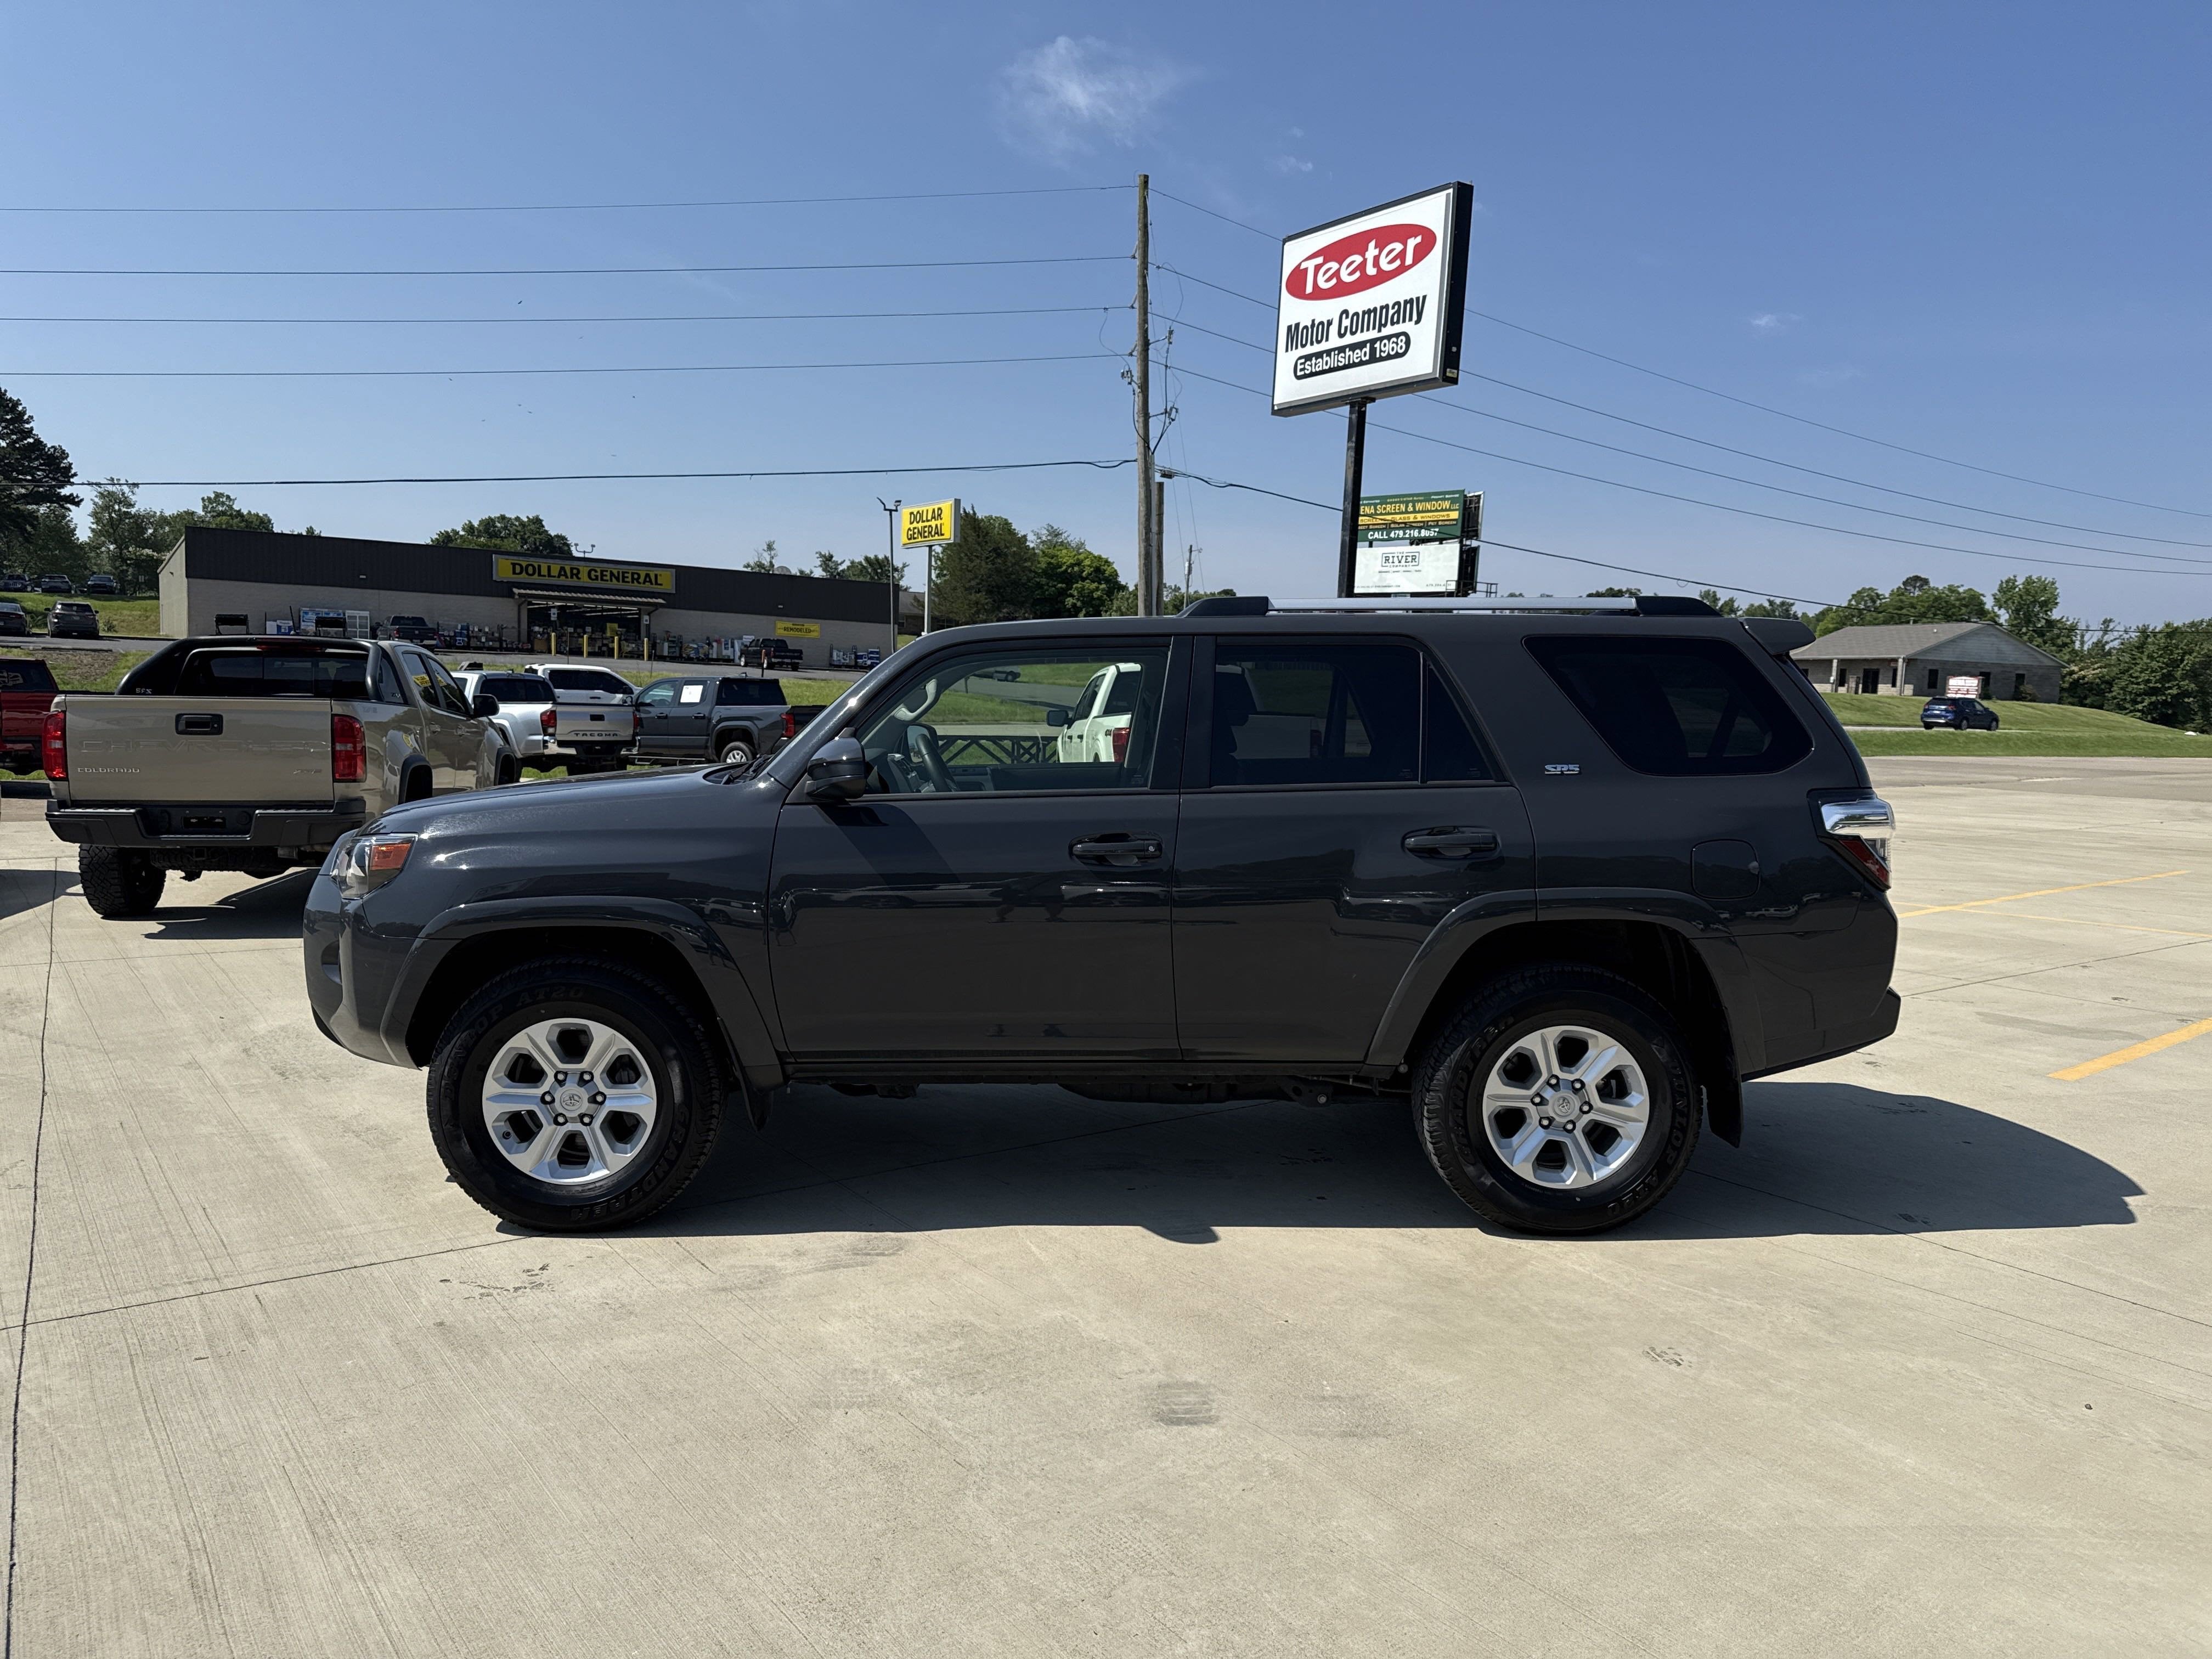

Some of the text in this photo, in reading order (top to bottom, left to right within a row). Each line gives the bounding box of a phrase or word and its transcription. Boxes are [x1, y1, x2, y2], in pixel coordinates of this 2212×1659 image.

[1300, 234, 1422, 295] Teeter
[1285, 295, 1427, 353] Motor Company
[1297, 336, 1406, 376] Established 1968
[909, 507, 943, 525] DOLLAR
[1360, 505, 1375, 515] ENA
[1376, 503, 1406, 514] SCREEN
[1407, 502, 1413, 512] &
[1415, 500, 1451, 511] WINDOW
[906, 522, 945, 541] GENERAL
[1368, 531, 1389, 539] CALL
[1384, 555, 1418, 564] RIVER
[511, 562, 663, 586] DOLLAR GENERAL
[1544, 764, 1580, 774] SR5
[518, 985, 585, 1006] AT20
